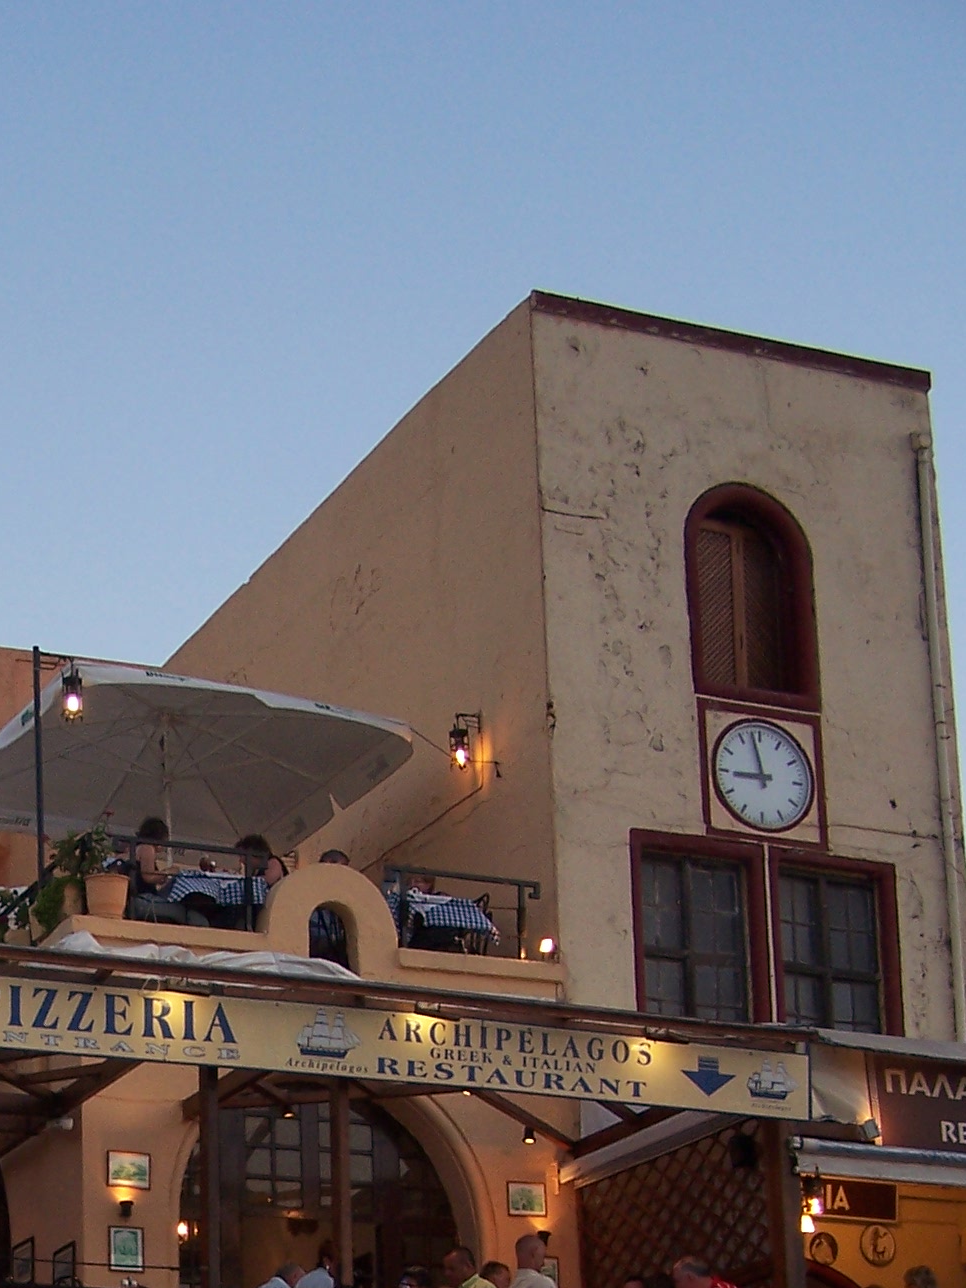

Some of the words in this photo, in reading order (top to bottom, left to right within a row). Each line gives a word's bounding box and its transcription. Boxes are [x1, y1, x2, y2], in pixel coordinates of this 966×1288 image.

[377, 1017, 654, 1067] ARCHIPELAGOS
[285, 1057, 369, 1075] Archipelagos
[376, 1056, 648, 1098] RESTAURANT
[429, 1047, 493, 1065] GREEK
[502, 1054, 512, 1066] &
[522, 1056, 596, 1075] ITALIAN
